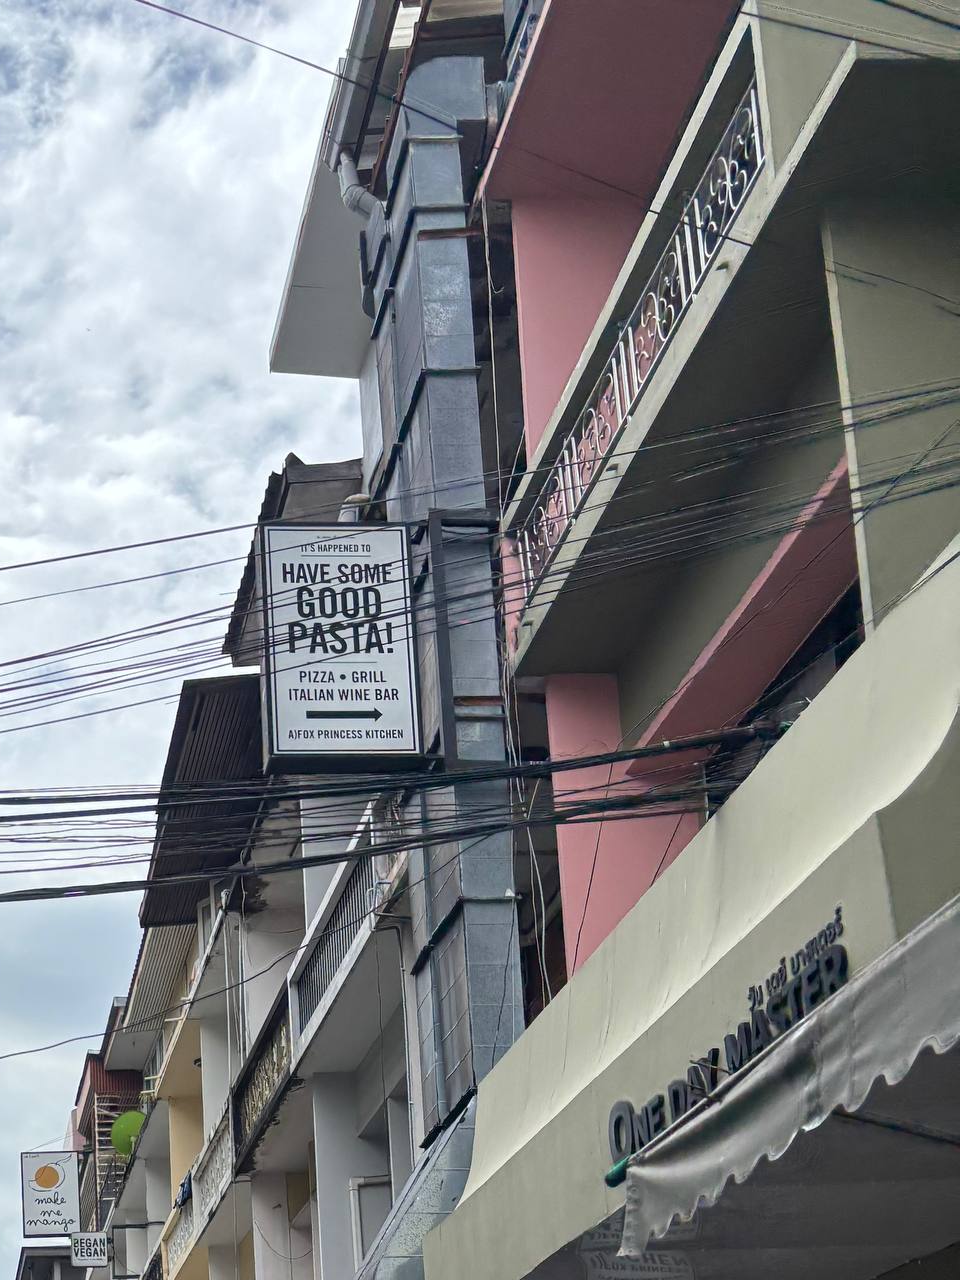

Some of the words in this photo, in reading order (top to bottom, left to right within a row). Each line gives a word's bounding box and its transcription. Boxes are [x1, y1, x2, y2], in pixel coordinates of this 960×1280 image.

[317, 544, 359, 553] HAPPENED
[361, 544, 371, 552] TO
[282, 563, 331, 584] HAVE
[337, 563, 393, 584] SOME
[297, 587, 382, 619] GOOD
[288, 622, 394, 654] PASTA!
[299, 671, 335, 683] PIZZA
[352, 671, 387, 683] GRILL
[289, 689, 334, 701] ITALIAN
[338, 689, 371, 701] WINE
[375, 688, 399, 700] BAR
[317, 730, 363, 739] PRINCESS
[365, 730, 404, 739] KITCHEN
[608, 1095, 666, 1163] ONE
[667, 1047, 720, 1124] DAY
[723, 944, 849, 1073] MASTER
[40, 1208, 63, 1217] me
[26, 1218, 76, 1232] mango
[73, 1238, 106, 1248] BEGAN
[73, 1248, 106, 1257] VEGAN
